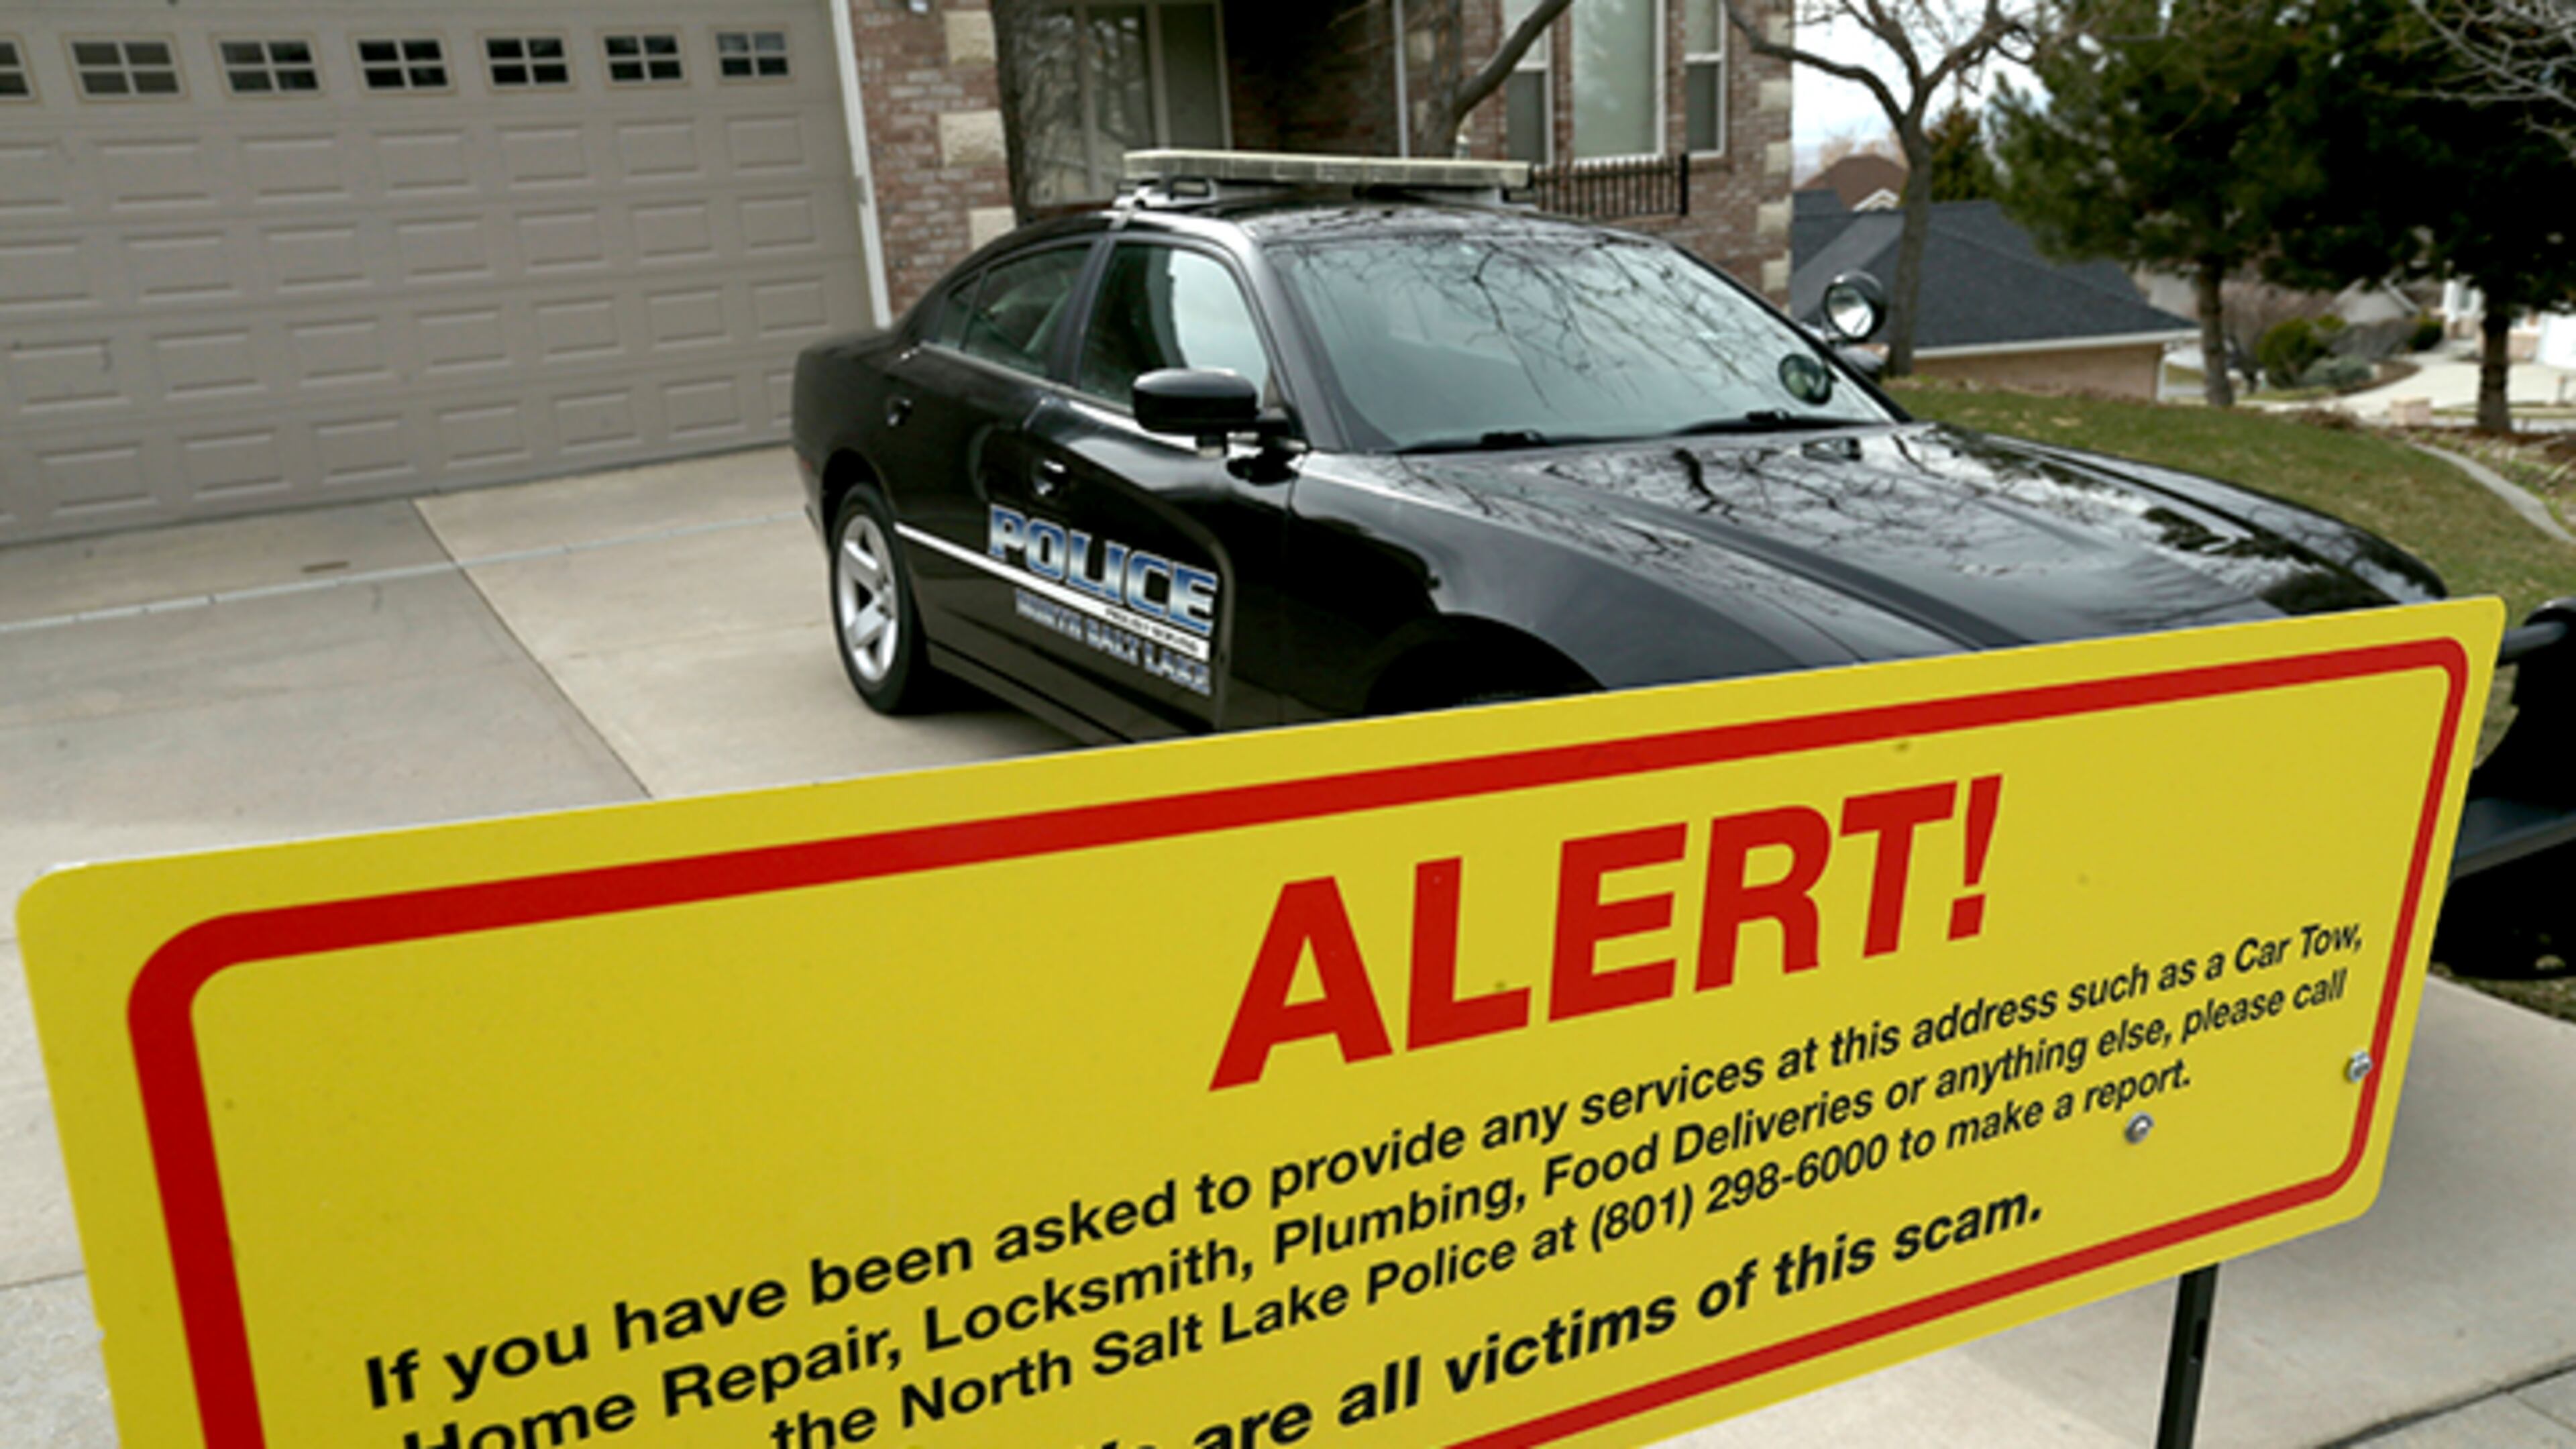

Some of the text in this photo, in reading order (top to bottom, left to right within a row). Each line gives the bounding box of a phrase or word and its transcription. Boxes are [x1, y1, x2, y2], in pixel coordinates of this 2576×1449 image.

[987, 502, 1218, 637] POLICE
[1210, 775, 2002, 1091] ALERT!
[364, 922, 2363, 1411] If you have been asked to provide any services at this address such as a Car Tow,
[661, 1324, 902, 1419] Repair,
[923, 1238, 1254, 1353] Locksmith,
[1273, 1177, 1527, 1266] Plumbing,
[1543, 1130, 1660, 1198] Food
[1672, 1088, 1874, 1166] Deliveries
[1884, 1075, 1929, 1112] or
[1933, 1036, 2089, 1099] anything
[2096, 1017, 2173, 1059] else,
[2180, 989, 2286, 1045] please
[2292, 967, 2348, 1011] call
[769, 1058, 2192, 1449] the North Salt Lake Police at (801) 298-6000 to make a report.
[1336, 1354, 1422, 1428] all
[1444, 1294, 1677, 1395] victims
[1697, 1256, 1760, 1320] of
[1772, 1232, 1877, 1297] this
[1892, 1192, 2043, 1263] scam.
